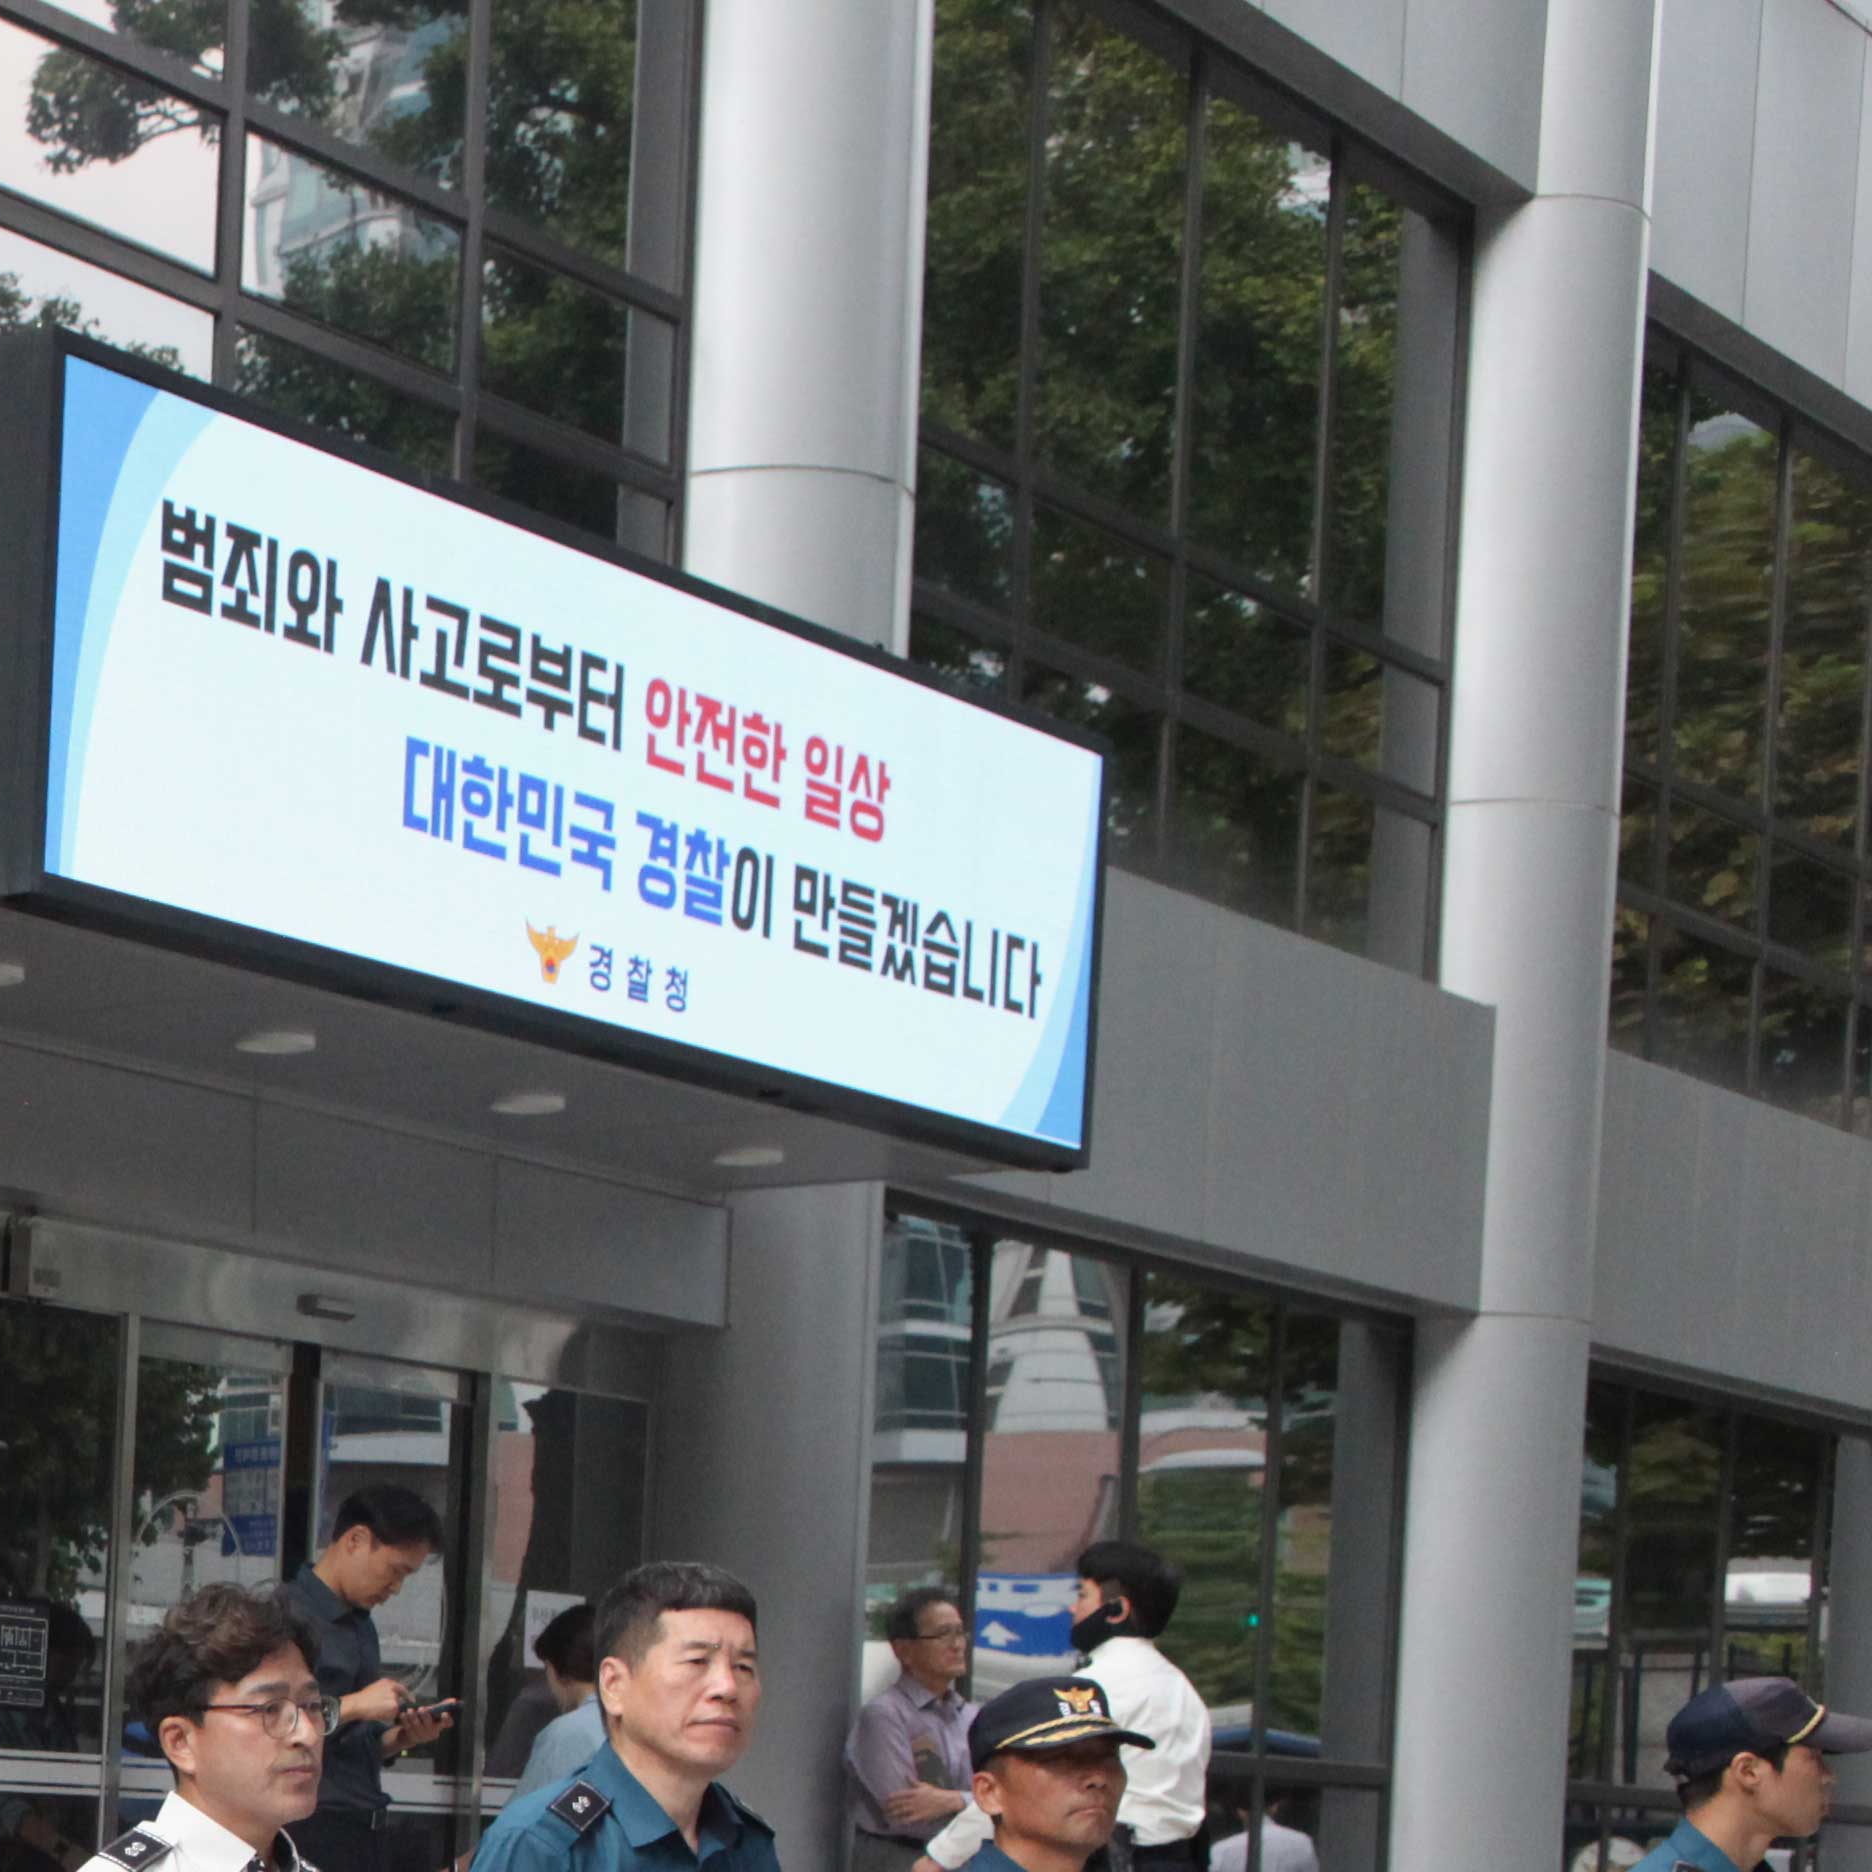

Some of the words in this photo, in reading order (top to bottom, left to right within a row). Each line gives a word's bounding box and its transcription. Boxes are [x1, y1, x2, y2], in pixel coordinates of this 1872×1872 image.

[160, 497, 342, 654] 범죄와
[359, 575, 624, 753] 사고로부터
[642, 676, 788, 812] 안전한
[803, 733, 891, 845] 일상
[401, 735, 618, 893] 대한민국
[634, 811, 775, 938] 경찰이
[792, 870, 1042, 1021] 만들겠습니다
[587, 942, 690, 1014] 경찰청
